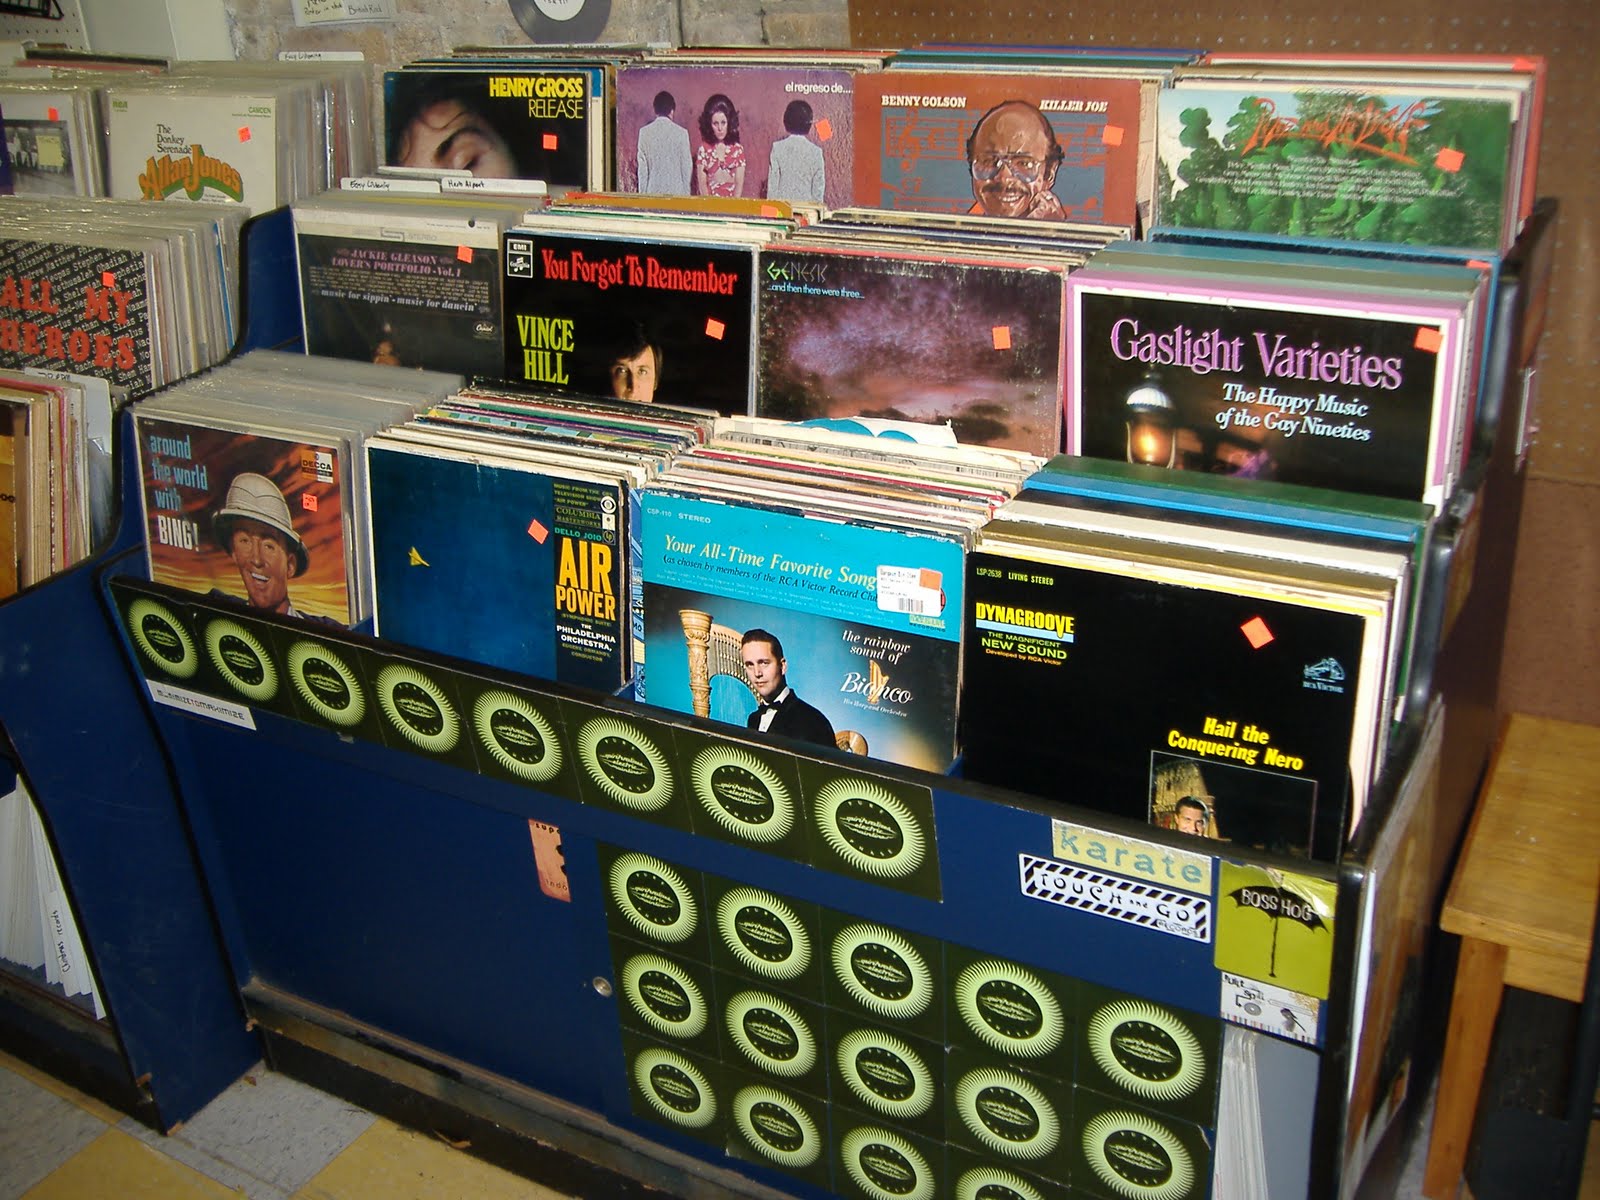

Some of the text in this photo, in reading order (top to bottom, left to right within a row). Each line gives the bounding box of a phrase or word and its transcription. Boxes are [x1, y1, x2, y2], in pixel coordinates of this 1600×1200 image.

[489, 77, 584, 98] HENRY GROSS
[785, 82, 794, 93] el
[794, 84, 830, 95] regreso
[529, 99, 584, 119] RELEASE
[881, 95, 967, 109] BENNY GOLSON
[1039, 99, 1108, 112] KILLER JOE
[157, 124, 172, 134] The
[157, 134, 185, 145] Donkey
[157, 144, 192, 154] Serenade
[138, 144, 244, 201] Allan Jones
[351, 249, 438, 265] JACKIE GLEASON
[512, 243, 527, 252] EMI
[373, 261, 432, 276] PORTFOLIO
[541, 249, 738, 295] You Forgot To Remember
[767, 260, 828, 283] GENESIS
[0, 275, 59, 314] ALL
[321, 289, 347, 299] music
[348, 290, 361, 301] for
[397, 296, 424, 307] music
[426, 298, 440, 309] for
[786, 282, 802, 293] then
[803, 284, 820, 295] there
[822, 287, 840, 297] were
[85, 287, 133, 325] MY
[0, 318, 136, 369] HEROES
[516, 315, 575, 352] VINCE
[1110, 317, 1403, 390] Gaslight Varieties
[524, 349, 569, 385] HILL
[1222, 383, 1369, 417] The Happy Music
[1215, 408, 1372, 441] of the Gay Nineties
[149, 434, 192, 460] around
[151, 457, 208, 491] the world
[302, 459, 332, 470] DECCA
[155, 488, 182, 512] with
[556, 507, 600, 520] COLUMBIA
[678, 512, 712, 524] STEREO
[158, 515, 199, 552] BING!
[554, 527, 602, 541] DELLO JOIO
[558, 537, 613, 595] AIR
[665, 534, 696, 554] Your
[699, 542, 765, 567] All-Time
[769, 553, 833, 581] Favorite
[837, 565, 878, 591] Song
[677, 556, 702, 570] chosen
[704, 562, 715, 572] by
[716, 565, 751, 578] members
[752, 570, 762, 581] of
[763, 573, 776, 583] the
[778, 575, 798, 588] RCA
[801, 579, 826, 593] Victor
[829, 585, 858, 599] Record
[1008, 572, 1028, 582] LIVING
[1031, 575, 1054, 586] STEREO
[555, 585, 616, 621] POWER
[976, 602, 1074, 639] DYNAGROOVE
[556, 625, 616, 643] PHILADELPHIA
[842, 630, 911, 653] the rainbow
[988, 631, 1061, 648] THE MAGNIFICENT
[850, 645, 902, 665] sound of
[981, 638, 1067, 659] NEW SOUND
[985, 648, 1017, 658] Developed
[840, 672, 913, 704] Bianco
[1203, 716, 1270, 745] Hail the
[1167, 730, 1304, 771] Conquering Nero
[1060, 826, 1202, 884] karate
[1040, 873, 1190, 921] TOUCH and GO
[1241, 889, 1313, 921] BOSS HOG
